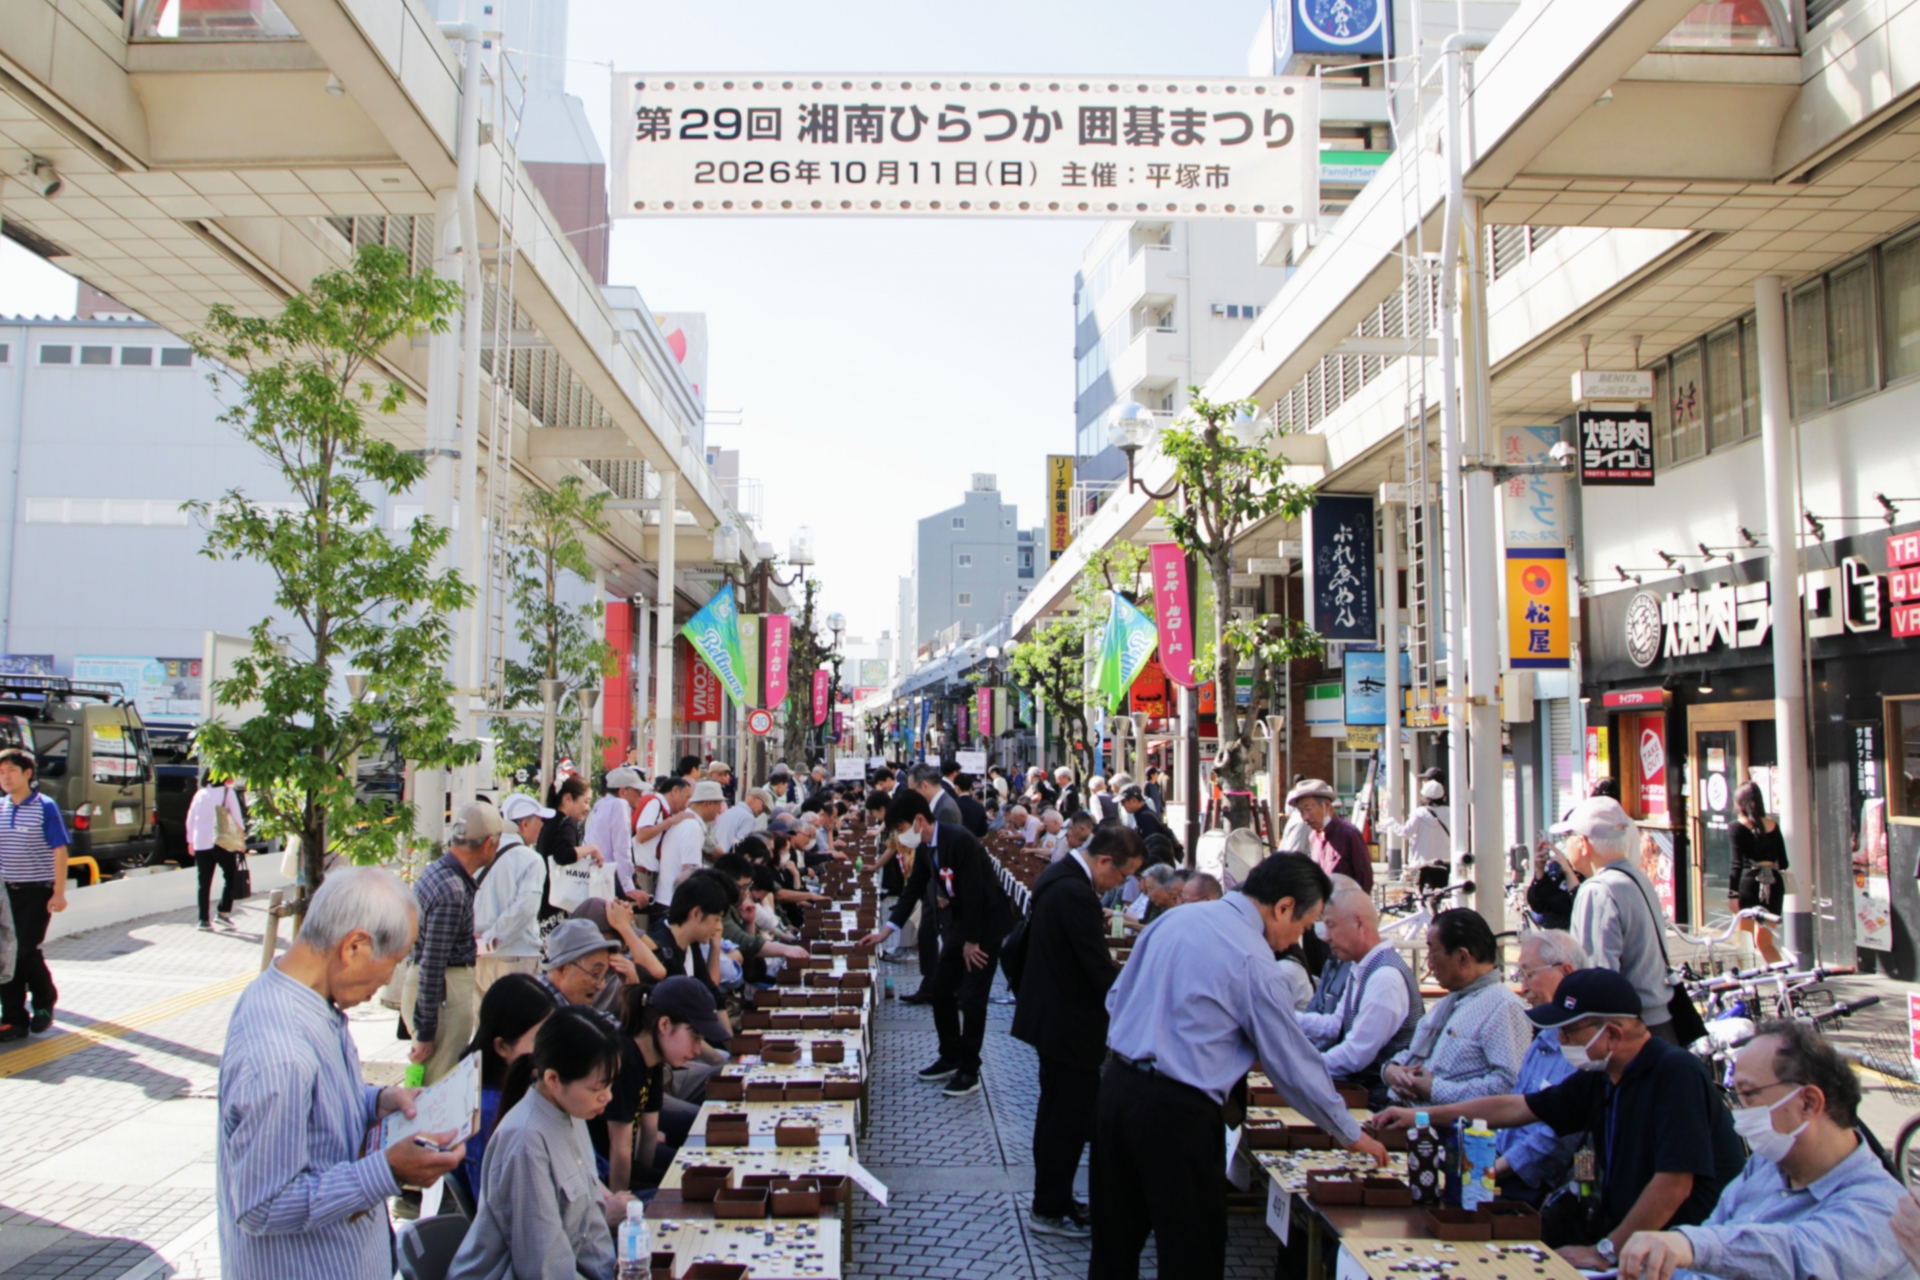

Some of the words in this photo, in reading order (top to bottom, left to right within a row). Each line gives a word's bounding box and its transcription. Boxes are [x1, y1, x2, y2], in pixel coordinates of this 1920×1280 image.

[635, 106, 783, 142] 第29回
[797, 103, 1063, 146] 湘南ひらつか
[1077, 105, 1295, 149] 囲碁まつり
[1061, 161, 1232, 190] 主催：平塚市
[1583, 419, 1650, 449] 焼肉
[1584, 449, 1637, 468] ライク
[1525, 600, 1551, 653] 松屋
[697, 629, 745, 699] Bellmare
[753, 716, 768, 728] 30
[1643, 741, 1660, 761] TAKE
[1646, 753, 1661, 772] OUT
